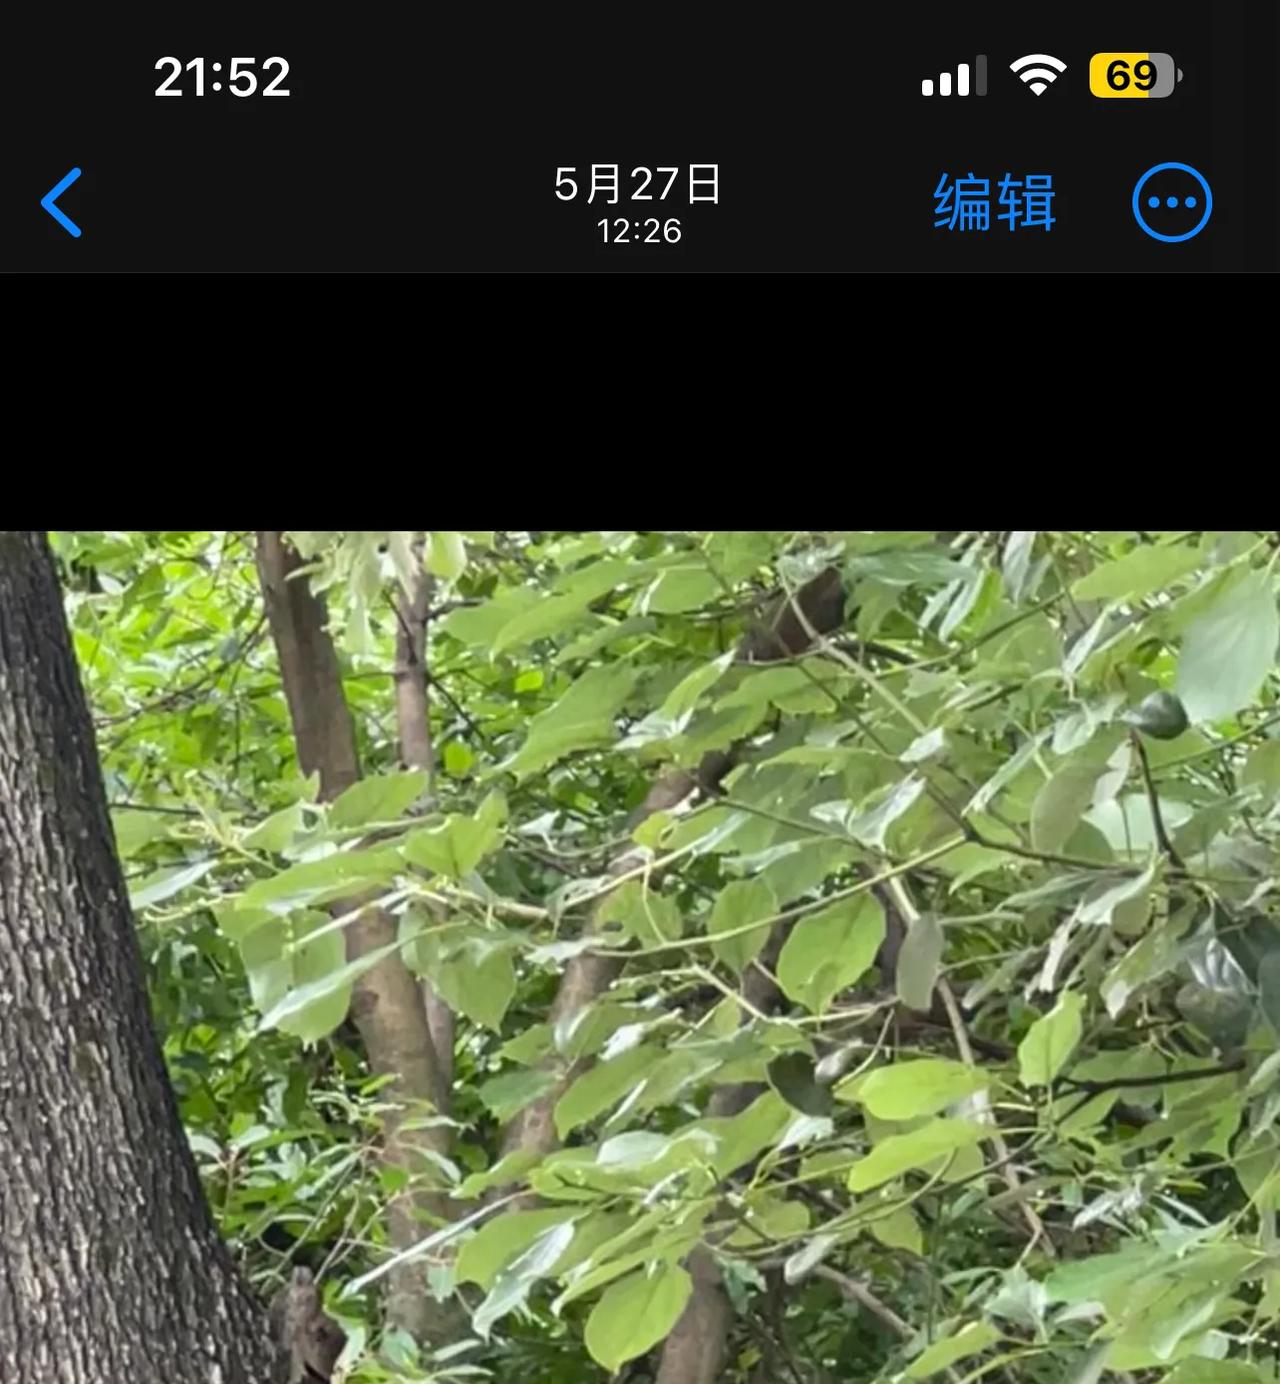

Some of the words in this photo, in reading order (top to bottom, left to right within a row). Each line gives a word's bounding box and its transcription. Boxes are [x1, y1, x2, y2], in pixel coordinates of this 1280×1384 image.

[154, 56, 291, 98] 21:52
[1105, 59, 1159, 92] 69
[555, 163, 720, 205] 5月27日
[932, 171, 1057, 232] 编辑
[597, 217, 682, 244] 12:26
